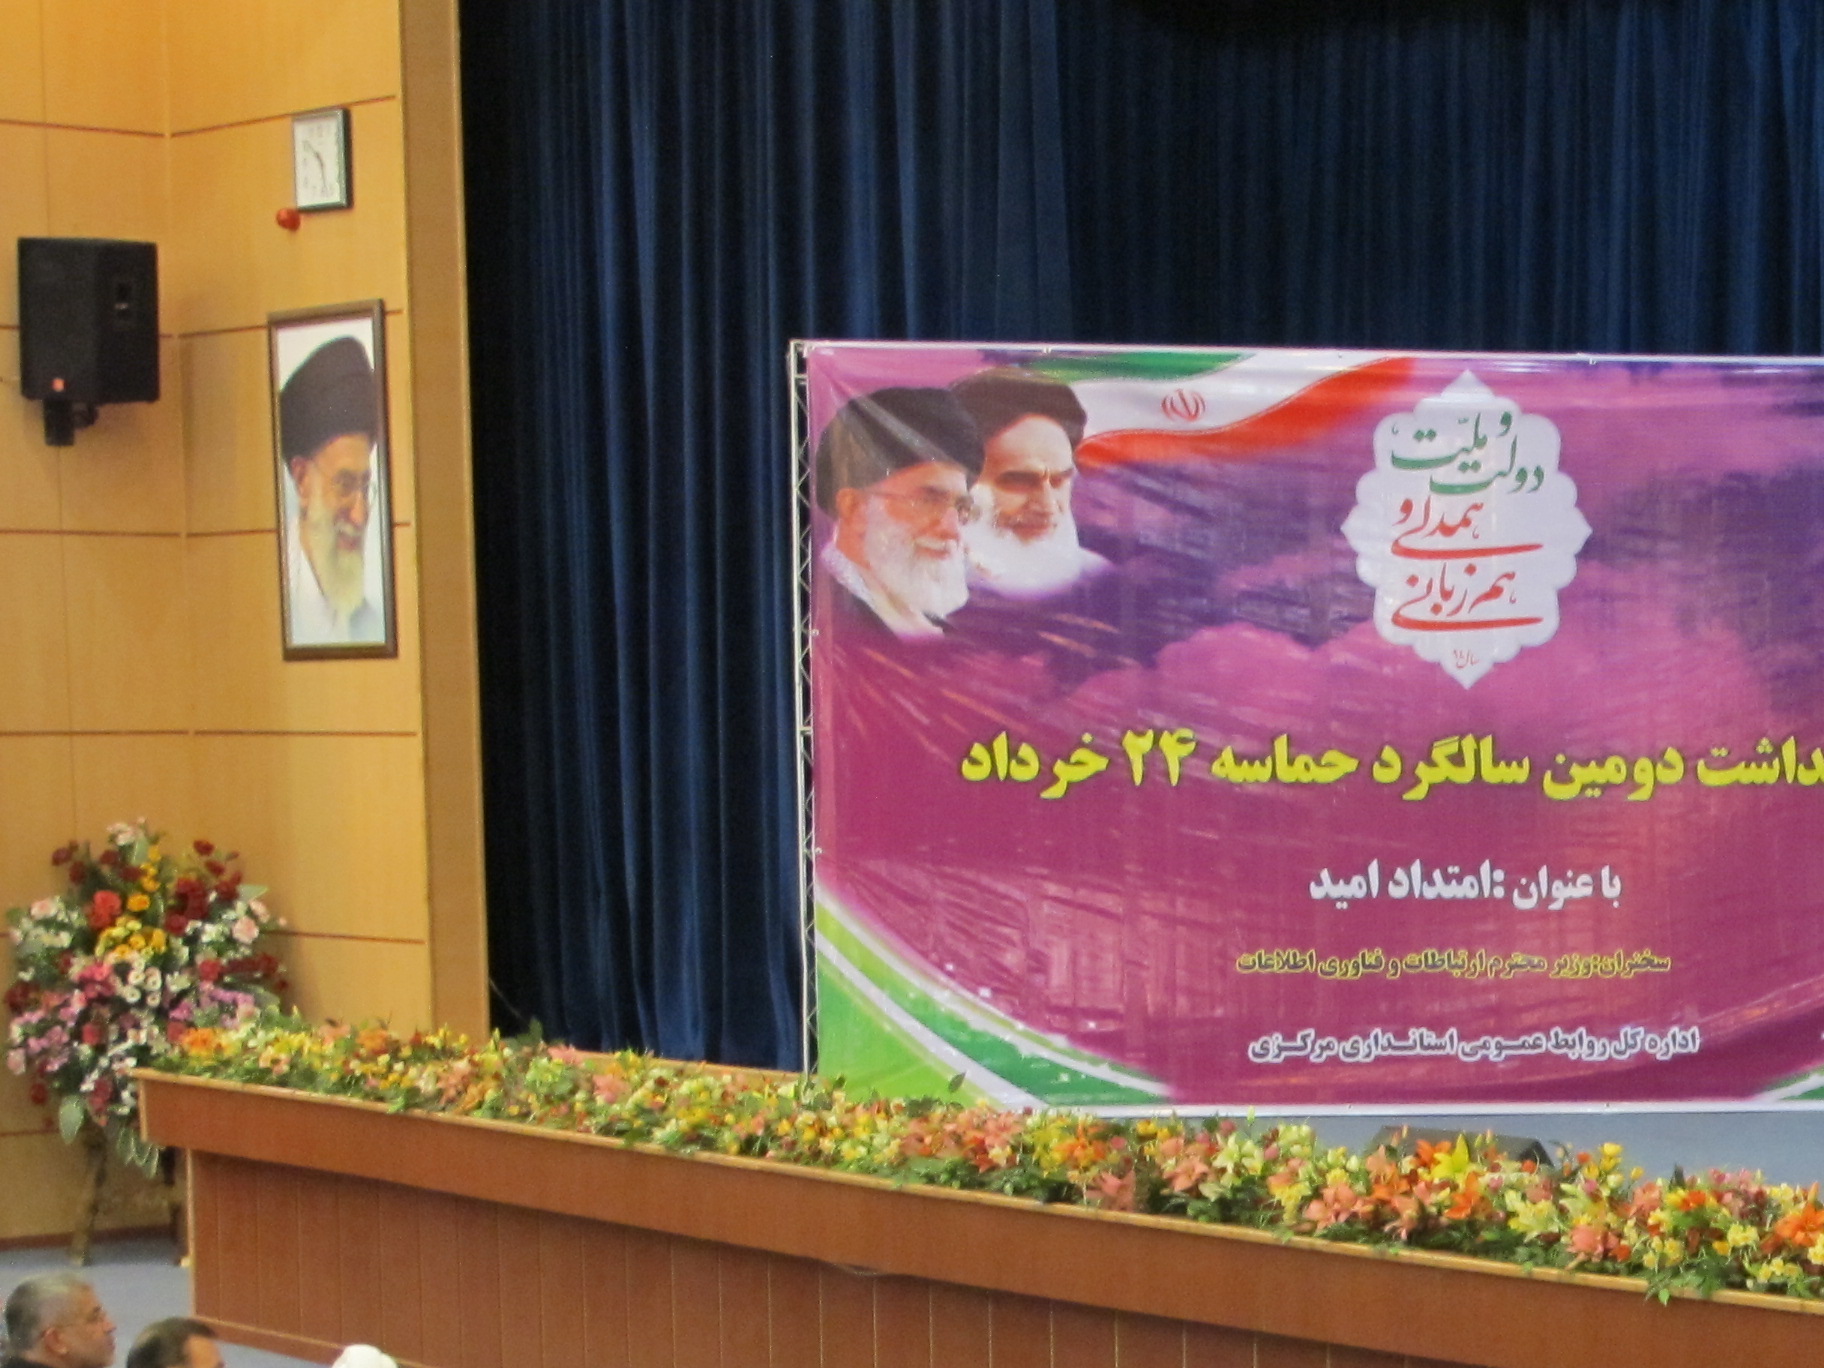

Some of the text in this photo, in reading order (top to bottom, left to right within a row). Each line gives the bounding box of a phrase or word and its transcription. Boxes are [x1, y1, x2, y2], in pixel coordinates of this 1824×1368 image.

[1429, 434, 1544, 495] دولت
[1497, 411, 1512, 437] و
[1392, 498, 1413, 526] و
[960, 730, 1110, 799] خرداد
[1121, 728, 1197, 787] ۲۴
[1210, 733, 1359, 784] حماسه
[1372, 733, 1531, 800] سالگرد
[1542, 746, 1685, 800] دومین
[1309, 858, 1379, 910] امید
[1512, 864, 1594, 911] عنوان
[1600, 864, 1622, 909] با
[1236, 948, 1316, 973] اطلاعات
[1318, 948, 1385, 979] فناوری
[1386, 958, 1400, 979] و
[1403, 948, 1485, 978] ارتباطات
[1488, 952, 1548, 979] محترم
[1248, 1026, 1700, 1063] اداره کل روابط عمومی استانداری مرکزی
